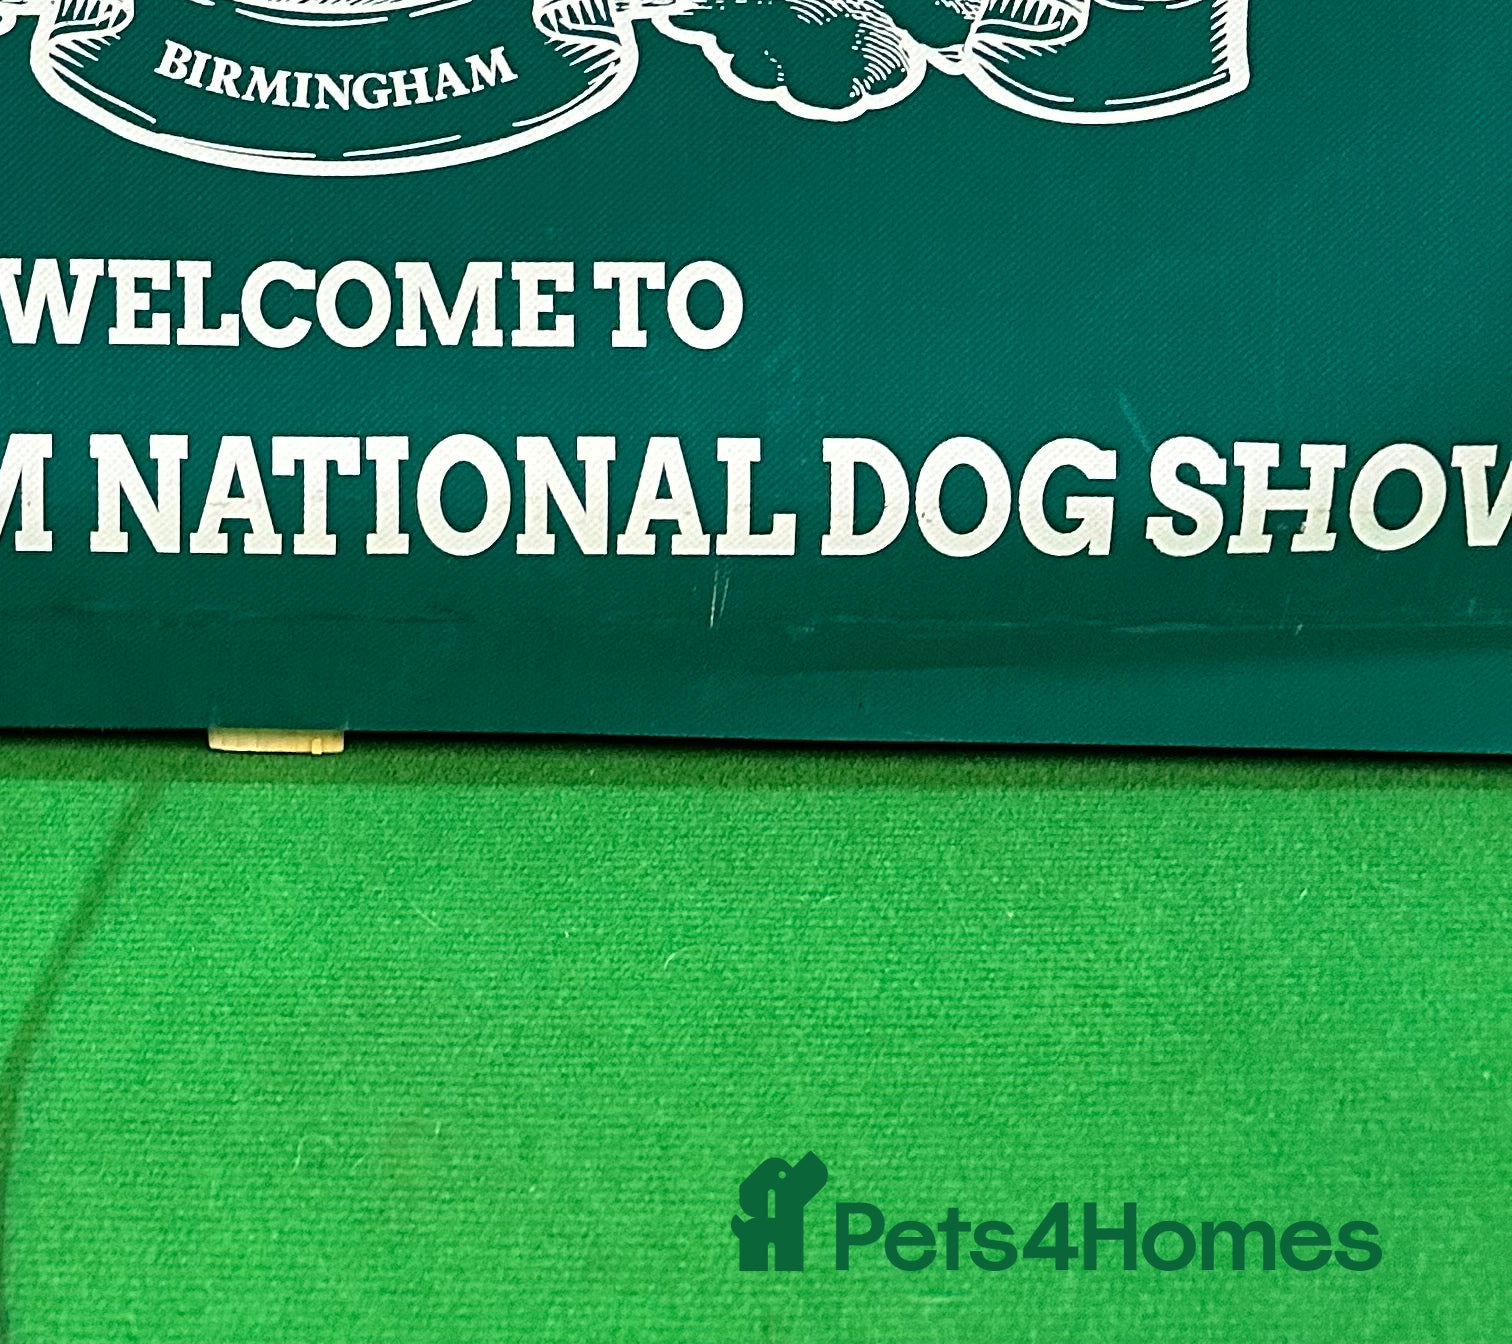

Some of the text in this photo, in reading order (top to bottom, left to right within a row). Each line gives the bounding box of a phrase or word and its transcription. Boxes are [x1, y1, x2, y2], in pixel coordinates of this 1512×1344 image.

[153, 39, 519, 111] BIRMINGHAM
[593, 260, 744, 350] TO
[89, 433, 798, 557] NATIONAL
[820, 436, 1118, 559] DOG
